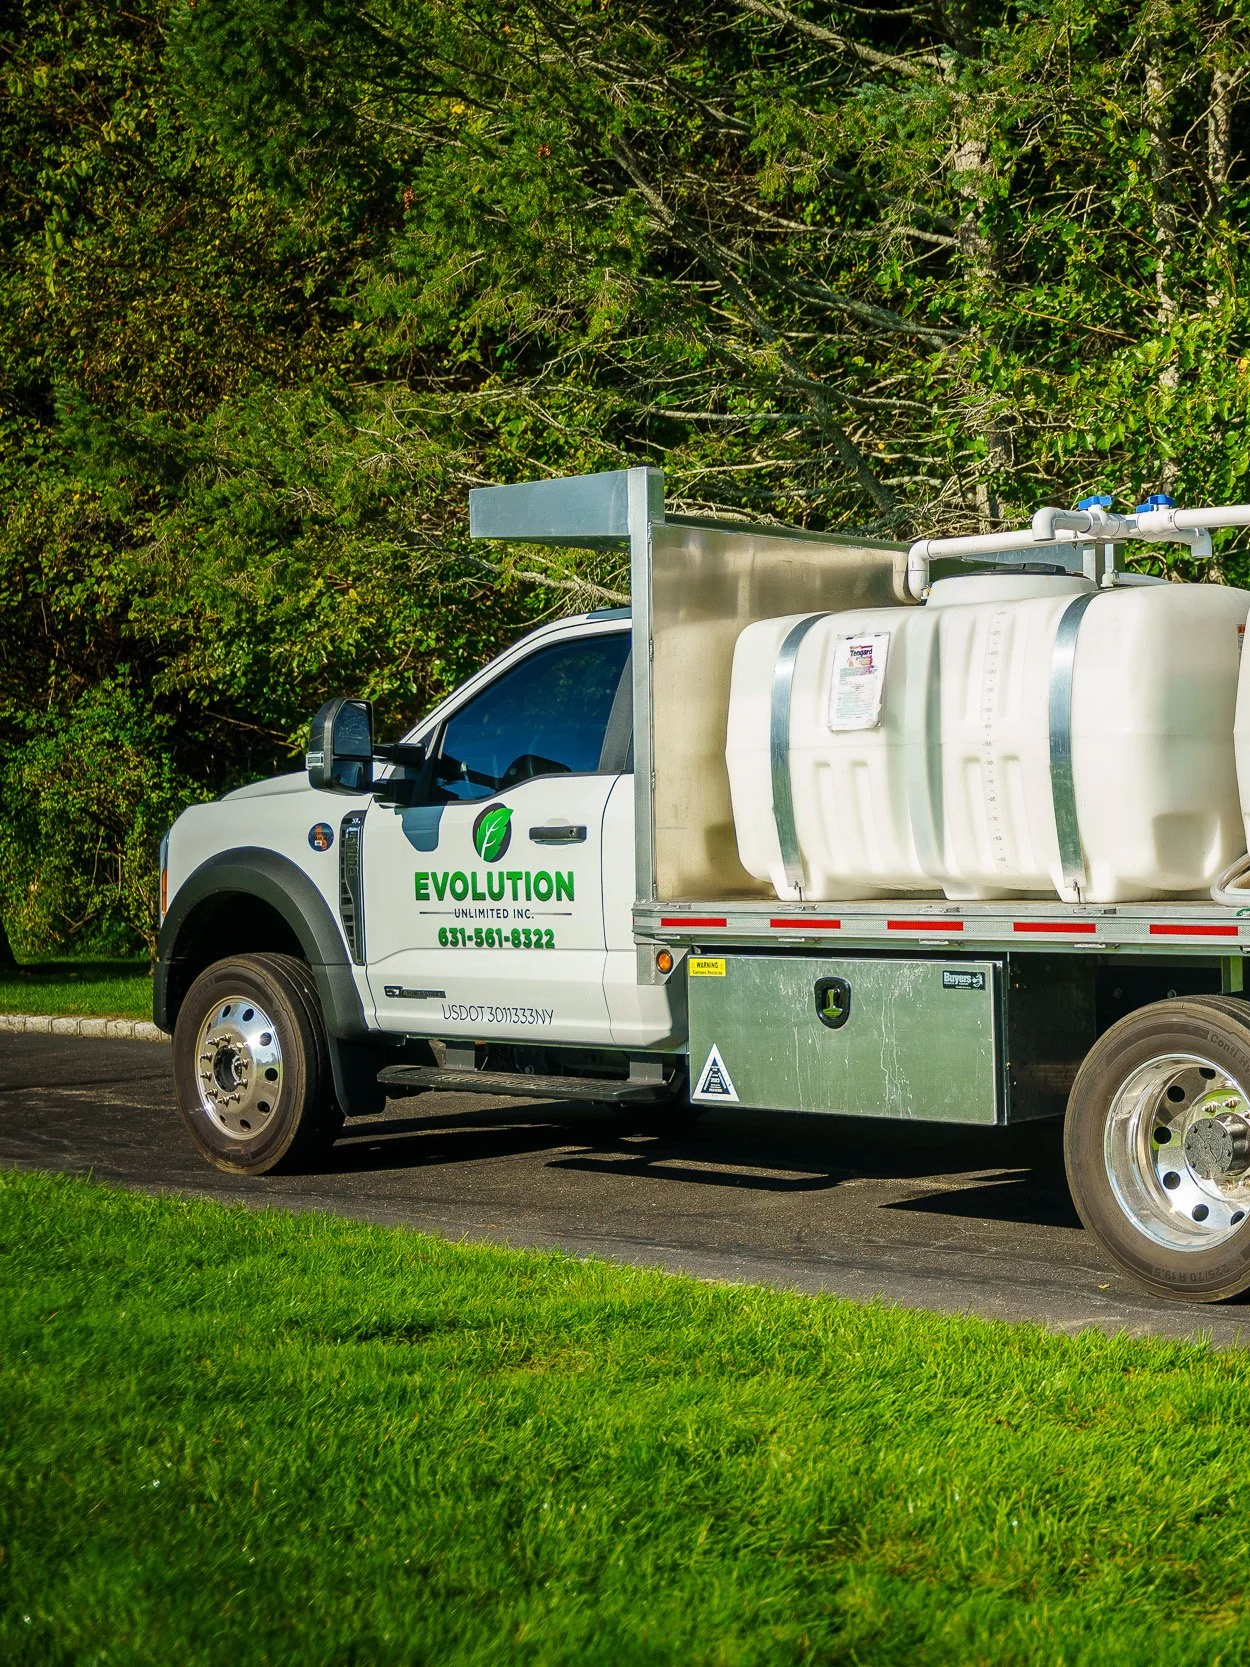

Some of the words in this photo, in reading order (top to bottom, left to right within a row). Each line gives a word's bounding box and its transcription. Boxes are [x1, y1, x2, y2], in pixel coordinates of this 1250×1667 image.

[414, 870, 575, 902] EVOLUTION
[454, 908, 509, 919] UNLIMITED
[513, 908, 535, 920] INC.
[437, 927, 556, 949] 631-561-8322
[944, 972, 971, 985] Buyers
[441, 1003, 485, 1022] USDOT
[487, 1005, 554, 1025] 3011333NY
